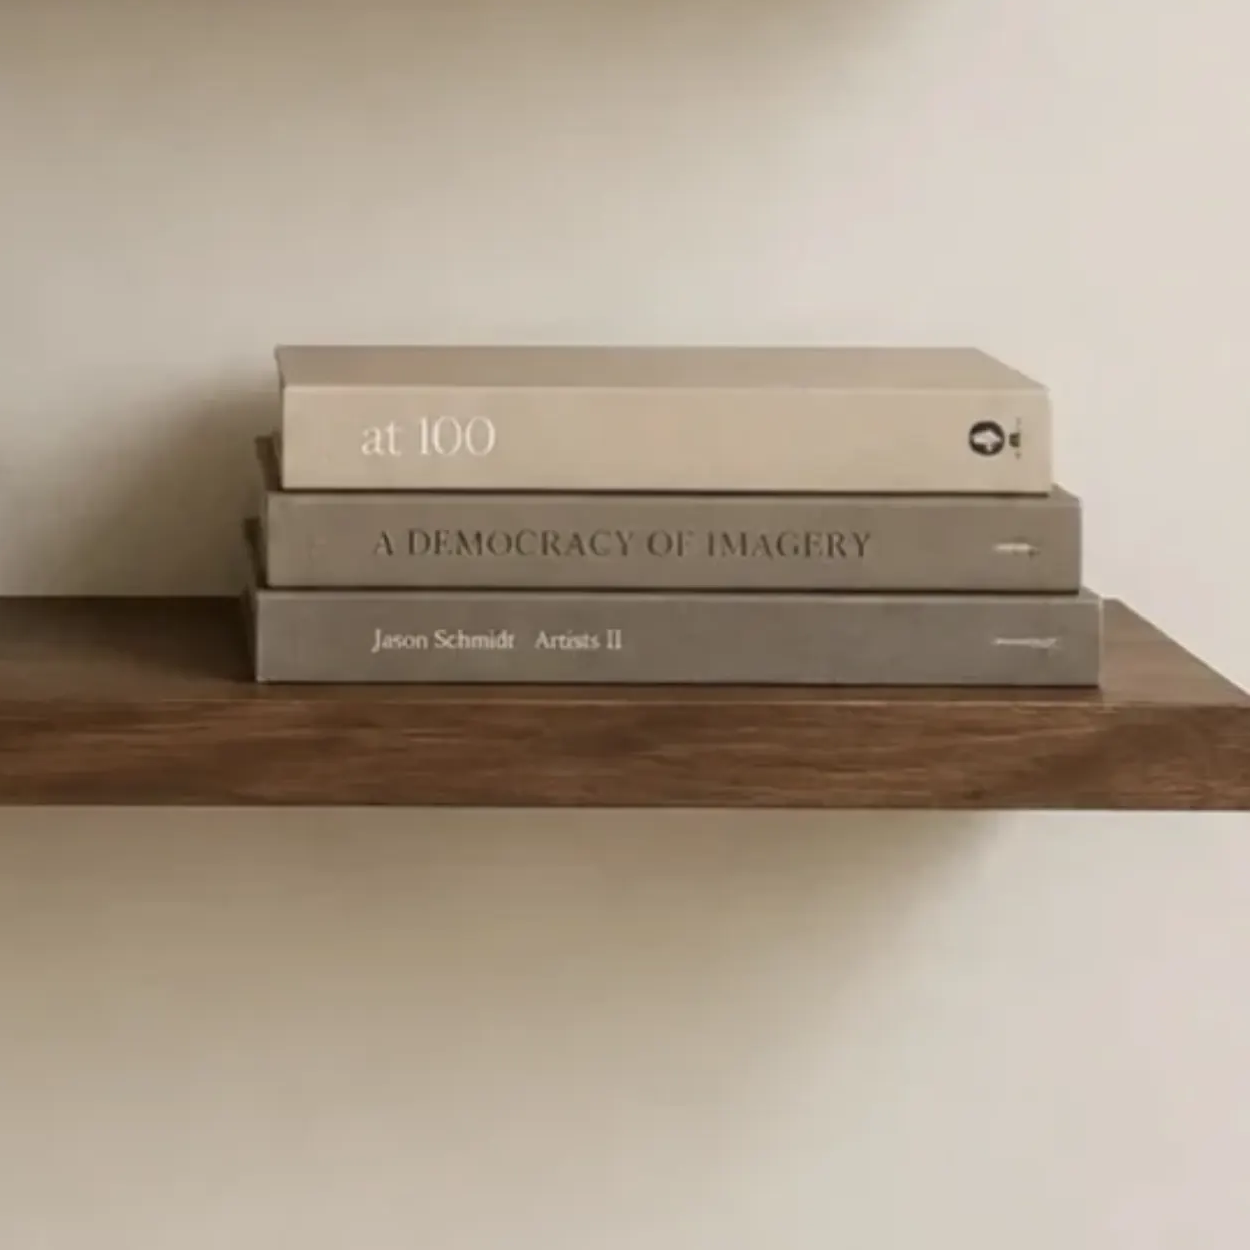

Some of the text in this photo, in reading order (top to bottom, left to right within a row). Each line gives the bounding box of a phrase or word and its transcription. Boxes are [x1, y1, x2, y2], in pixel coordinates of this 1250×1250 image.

[361, 415, 496, 456] at 100
[374, 528, 871, 559] A DEMOCRACY OF IMAGERY
[371, 628, 623, 653] Jason Schmidt Artists II
